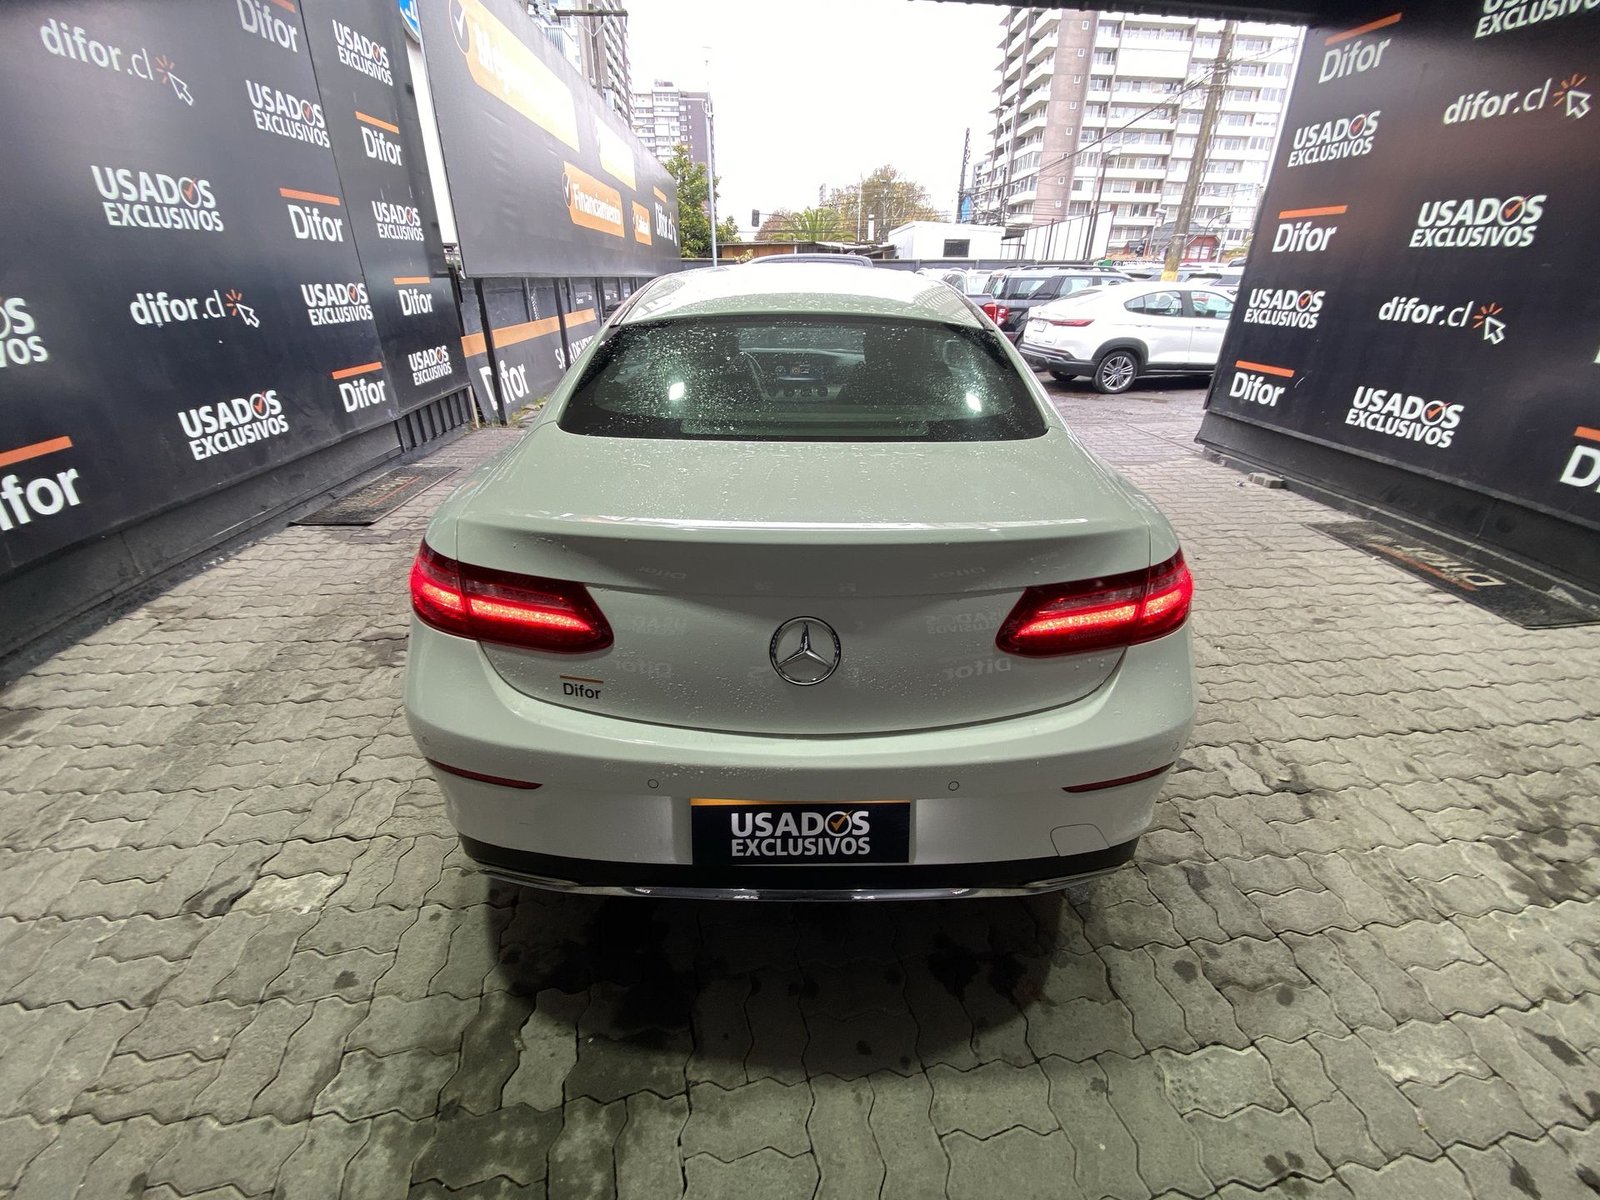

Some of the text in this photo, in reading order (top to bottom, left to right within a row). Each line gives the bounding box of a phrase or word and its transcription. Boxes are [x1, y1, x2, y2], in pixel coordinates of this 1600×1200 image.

[237, 0, 298, 53] Difor
[331, 19, 390, 69] USADOS
[41, 18, 154, 81] difor.cl
[336, 45, 394, 87] EXCLUSIVOS
[1318, 38, 1391, 84] Difor
[245, 80, 326, 129] USADOS
[1443, 78, 1553, 125] difor.cl
[252, 109, 332, 149] EXCLUSIVOS
[361, 126, 403, 167] Difor
[1293, 110, 1381, 150] USADOS
[1287, 136, 1374, 168] EXCLUSIVOS
[91, 165, 217, 209] USADOS
[102, 202, 225, 232] EXCLUSIVOS
[287, 204, 344, 242] Difor
[371, 200, 421, 226] USADOS
[1417, 194, 1547, 228] USADOS
[376, 222, 424, 242] EXCLUSIVOS
[1272, 221, 1338, 253] Difor
[1409, 225, 1538, 249] EXCLUSIVOS
[130, 289, 226, 325] difor.cl
[300, 282, 369, 308] USADOS
[398, 289, 433, 316] Difor
[1248, 288, 1326, 314] USADOS
[1378, 296, 1474, 327] difor.cl
[307, 304, 374, 326] EXCLUSIVOS
[1243, 307, 1319, 330] EXCLUSIVOS
[408, 344, 450, 372] USADOS
[412, 361, 452, 386] EXCLUSIVOS
[339, 378, 387, 413] Difor
[1229, 371, 1285, 407] Difor
[178, 389, 282, 439] USADOS
[1352, 385, 1465, 430] USADOS
[188, 414, 290, 461] EXCLUSIVOS
[1345, 408, 1455, 449] EXCLUSIVOS
[562, 682, 601, 699] Difor
[730, 811, 870, 837] USADOS
[731, 837, 870, 857] EXCLUSIVOS
